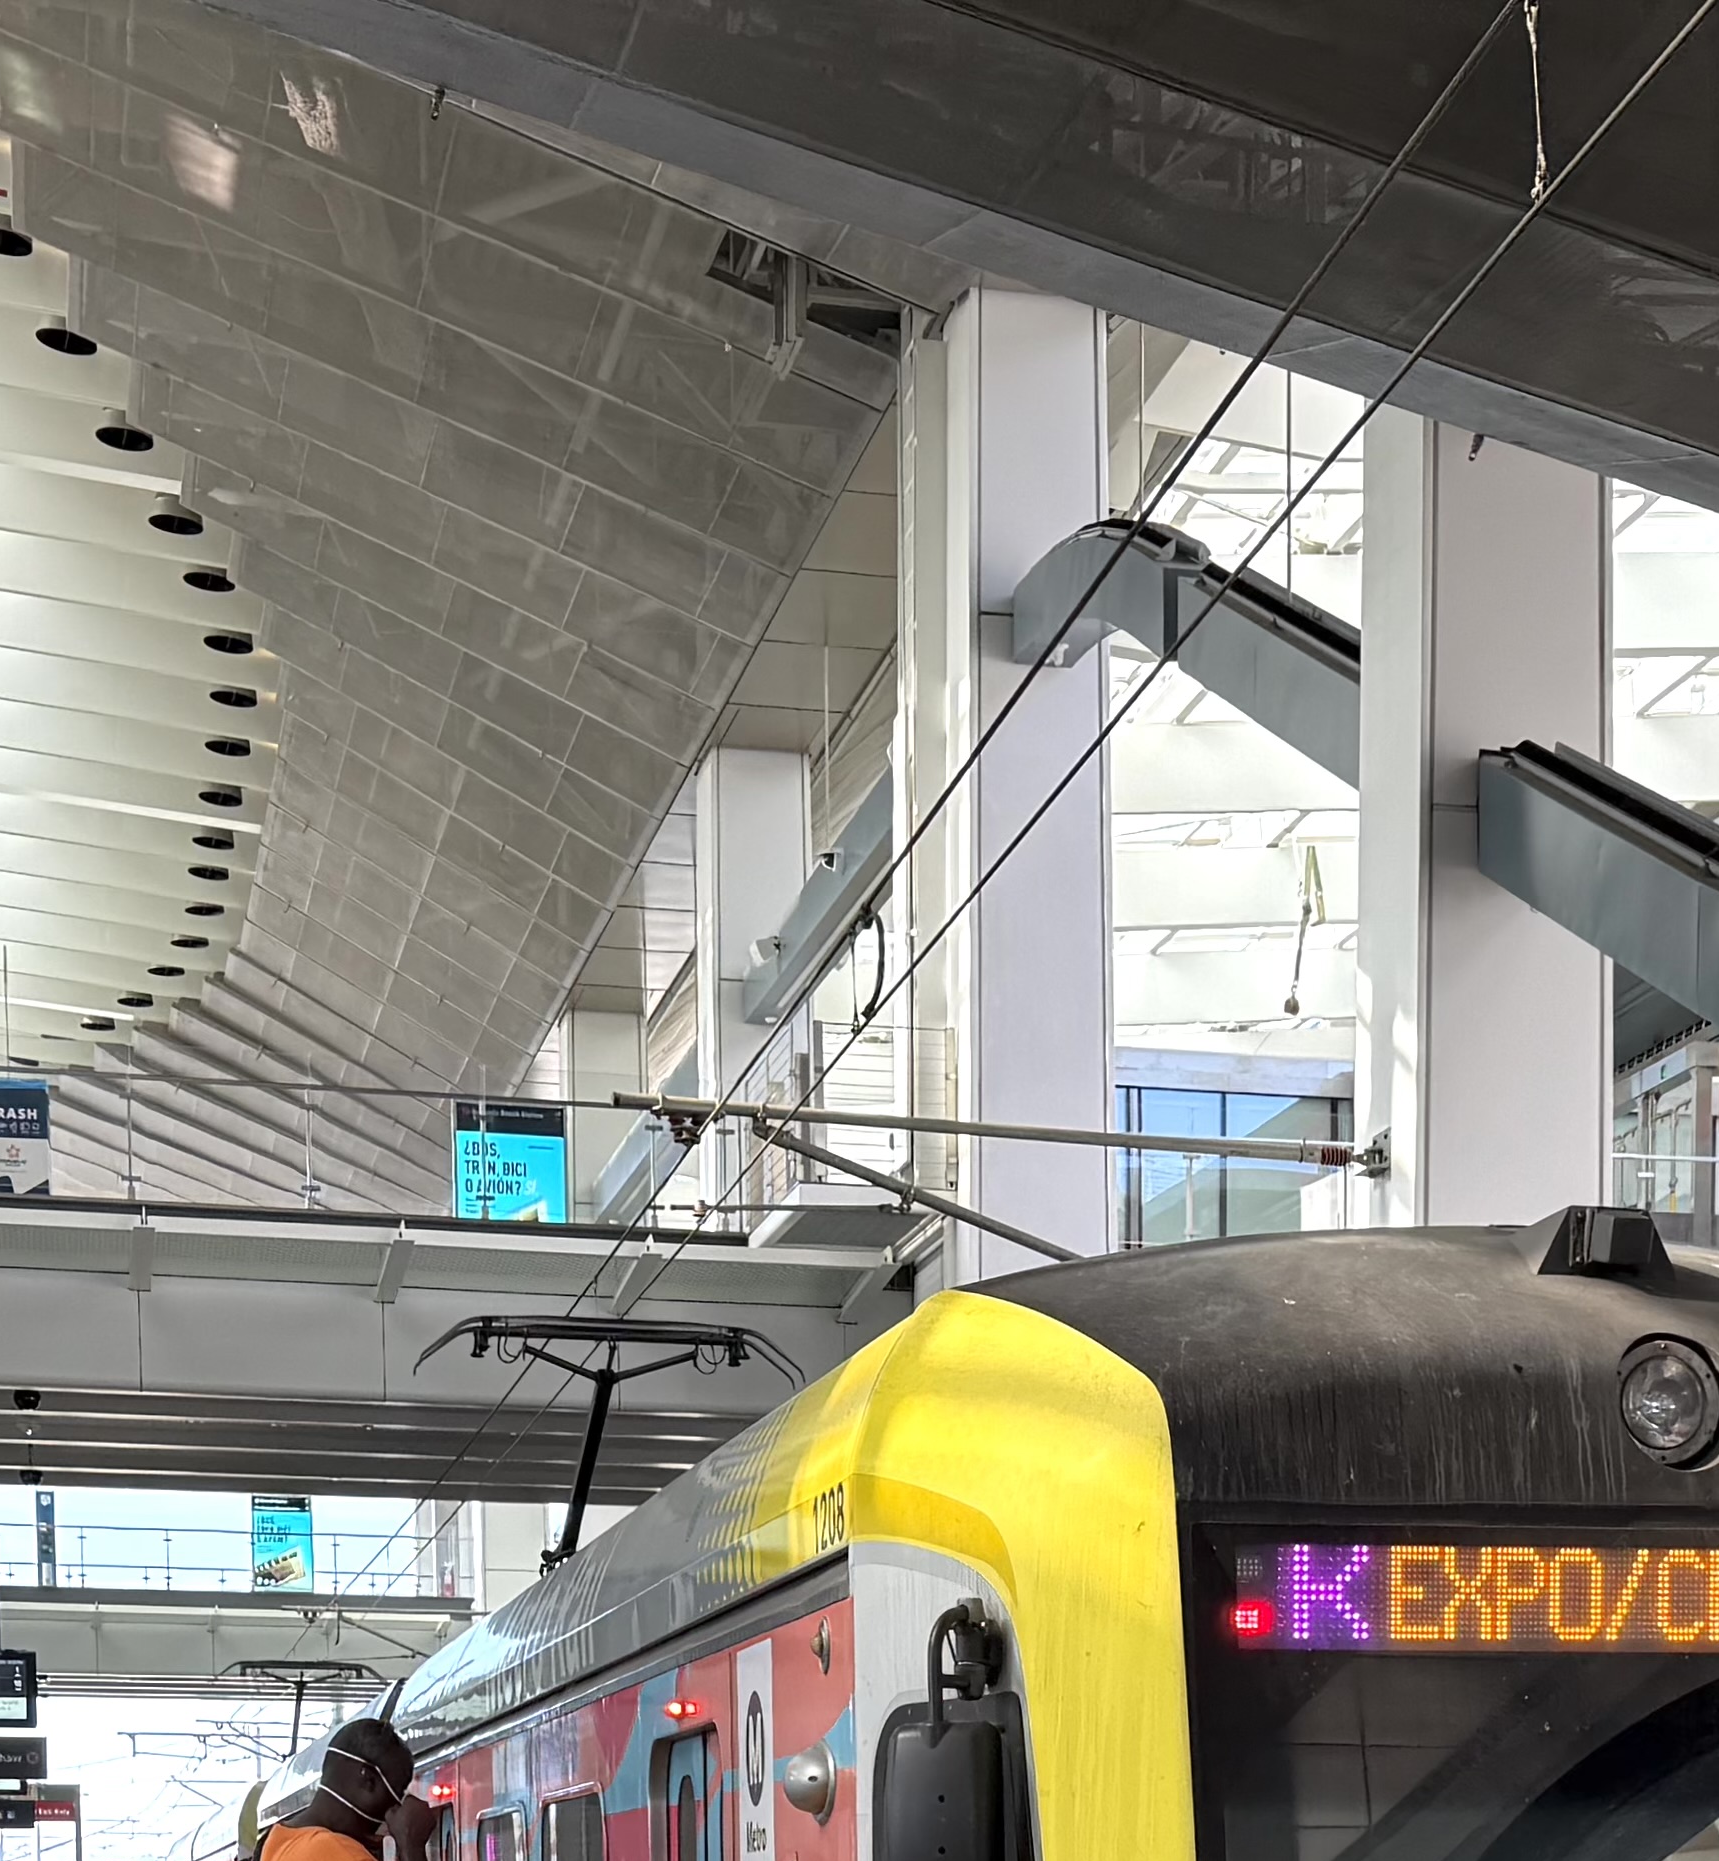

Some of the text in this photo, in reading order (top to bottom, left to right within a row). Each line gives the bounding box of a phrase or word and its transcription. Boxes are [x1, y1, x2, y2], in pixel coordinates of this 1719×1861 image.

[464, 1160, 500, 1178] TRN,
[812, 1482, 845, 1554] 1208
[1292, 1543, 1371, 1642] K
